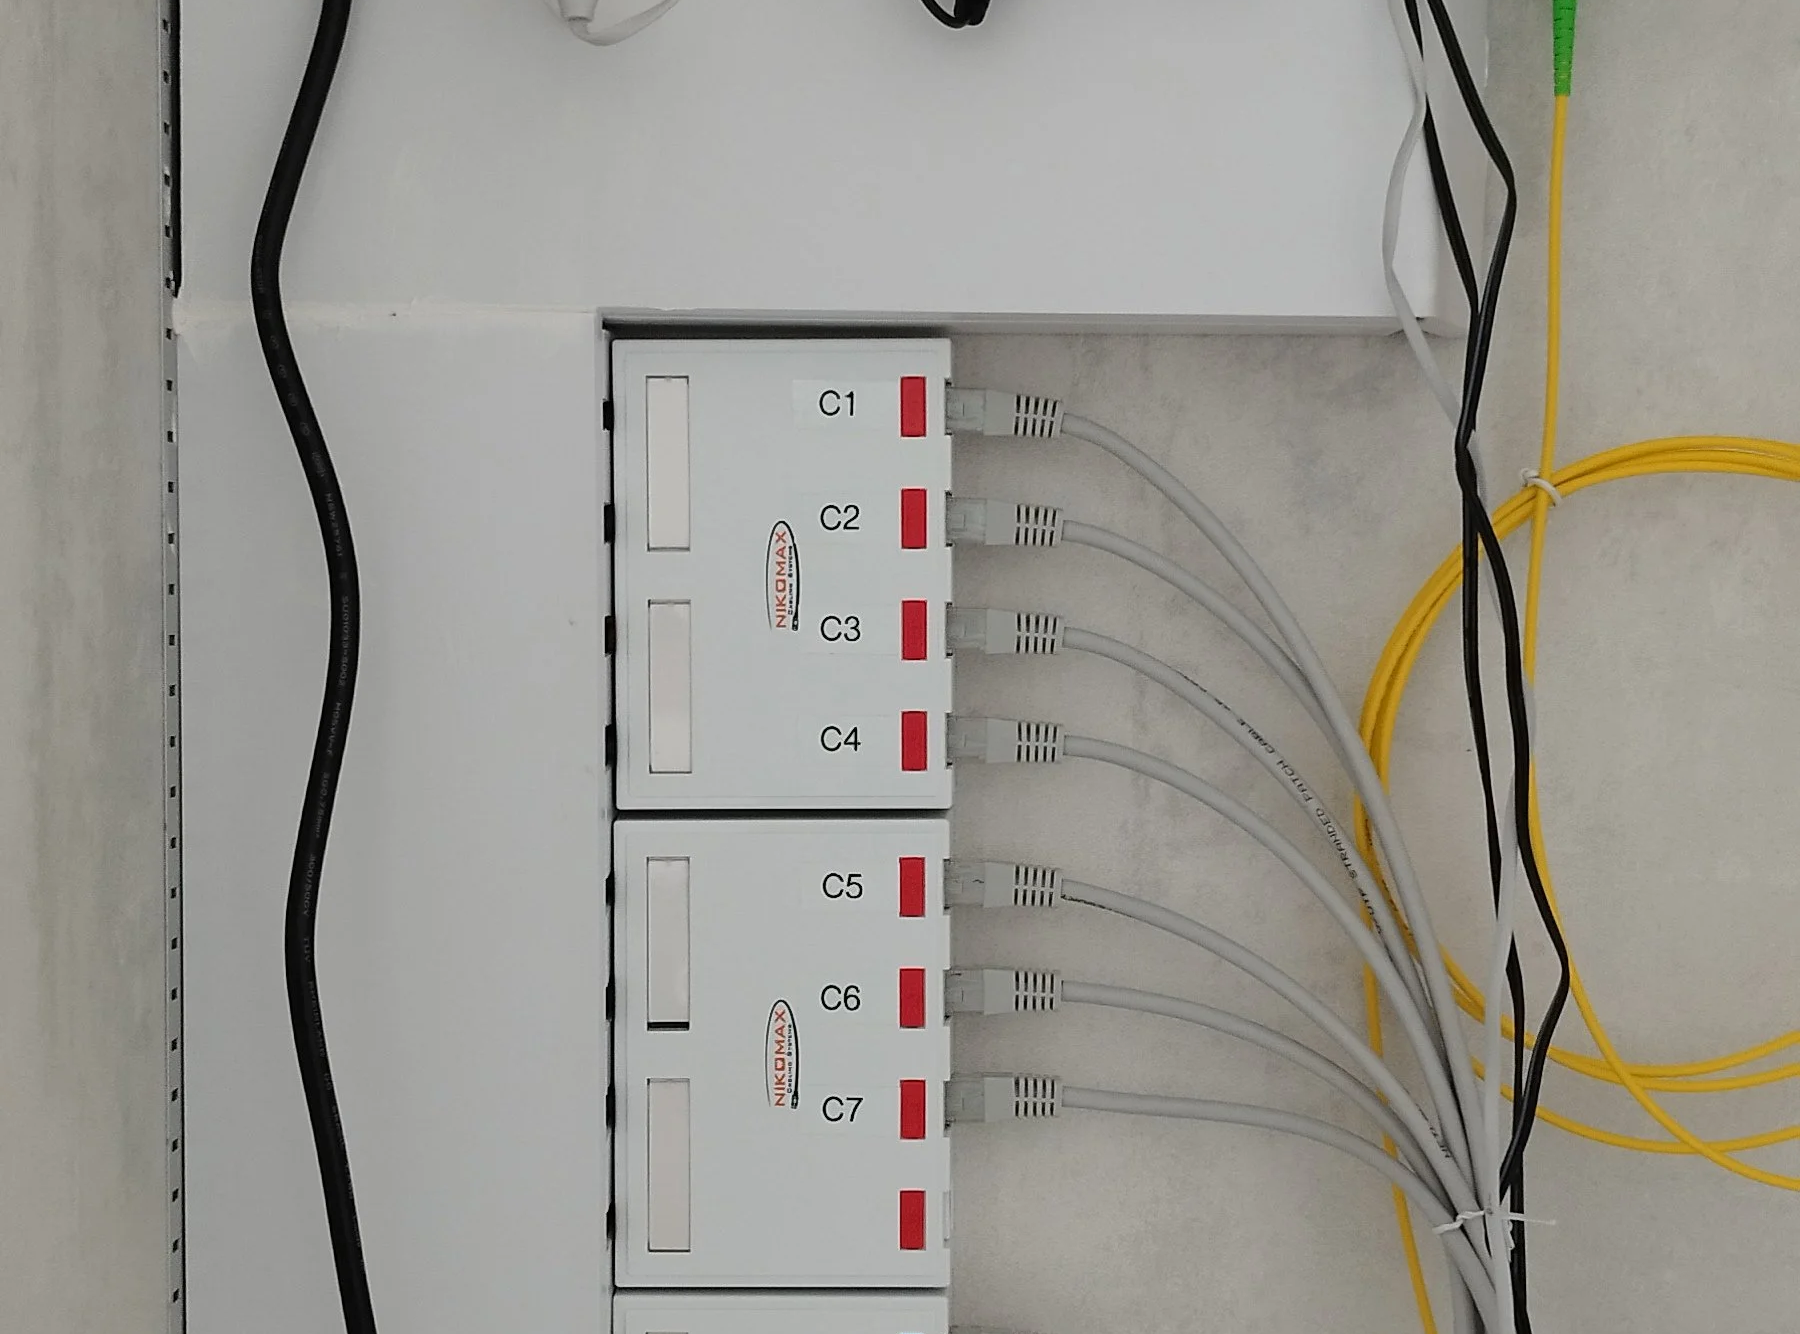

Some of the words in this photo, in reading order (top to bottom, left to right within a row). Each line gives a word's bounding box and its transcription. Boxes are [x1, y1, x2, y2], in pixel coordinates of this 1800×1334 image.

[820, 390, 854, 416] C1
[821, 505, 859, 530] C2
[775, 530, 787, 628] NIKOMAX
[821, 616, 860, 641] C3
[821, 726, 861, 751] C4
[1276, 760, 1313, 803] PATCH
[1315, 808, 1358, 879] STRANDED
[823, 873, 862, 898] C5
[821, 985, 860, 1011] C6
[774, 1009, 786, 1107] NIKOMAX
[823, 1096, 863, 1122] C7
